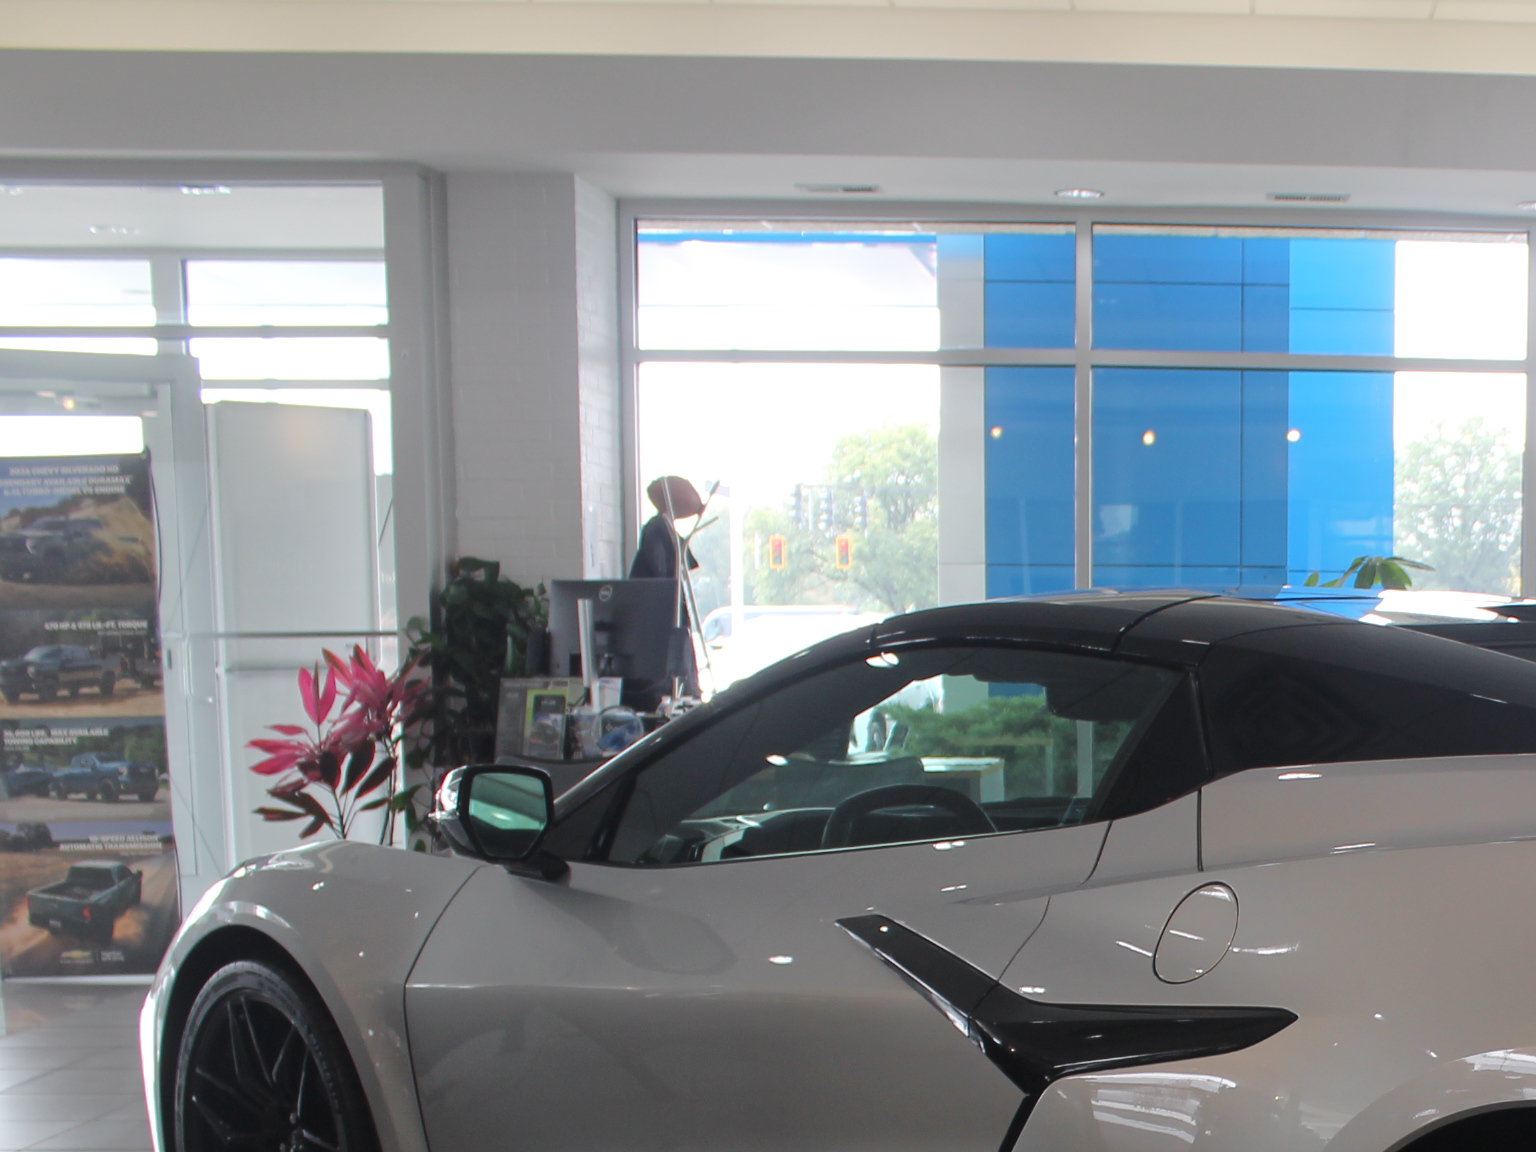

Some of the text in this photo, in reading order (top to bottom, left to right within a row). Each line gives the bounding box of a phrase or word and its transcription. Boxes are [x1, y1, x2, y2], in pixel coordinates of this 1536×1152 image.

[60, 465, 106, 475] SILVERADO
[117, 619, 148, 629] TORQUE
[68, 727, 109, 736] AVAILABLE
[4, 737, 77, 745] TOWING CAPABILITY
[59, 842, 162, 851] AUTOMATIC TRANSMISSION
